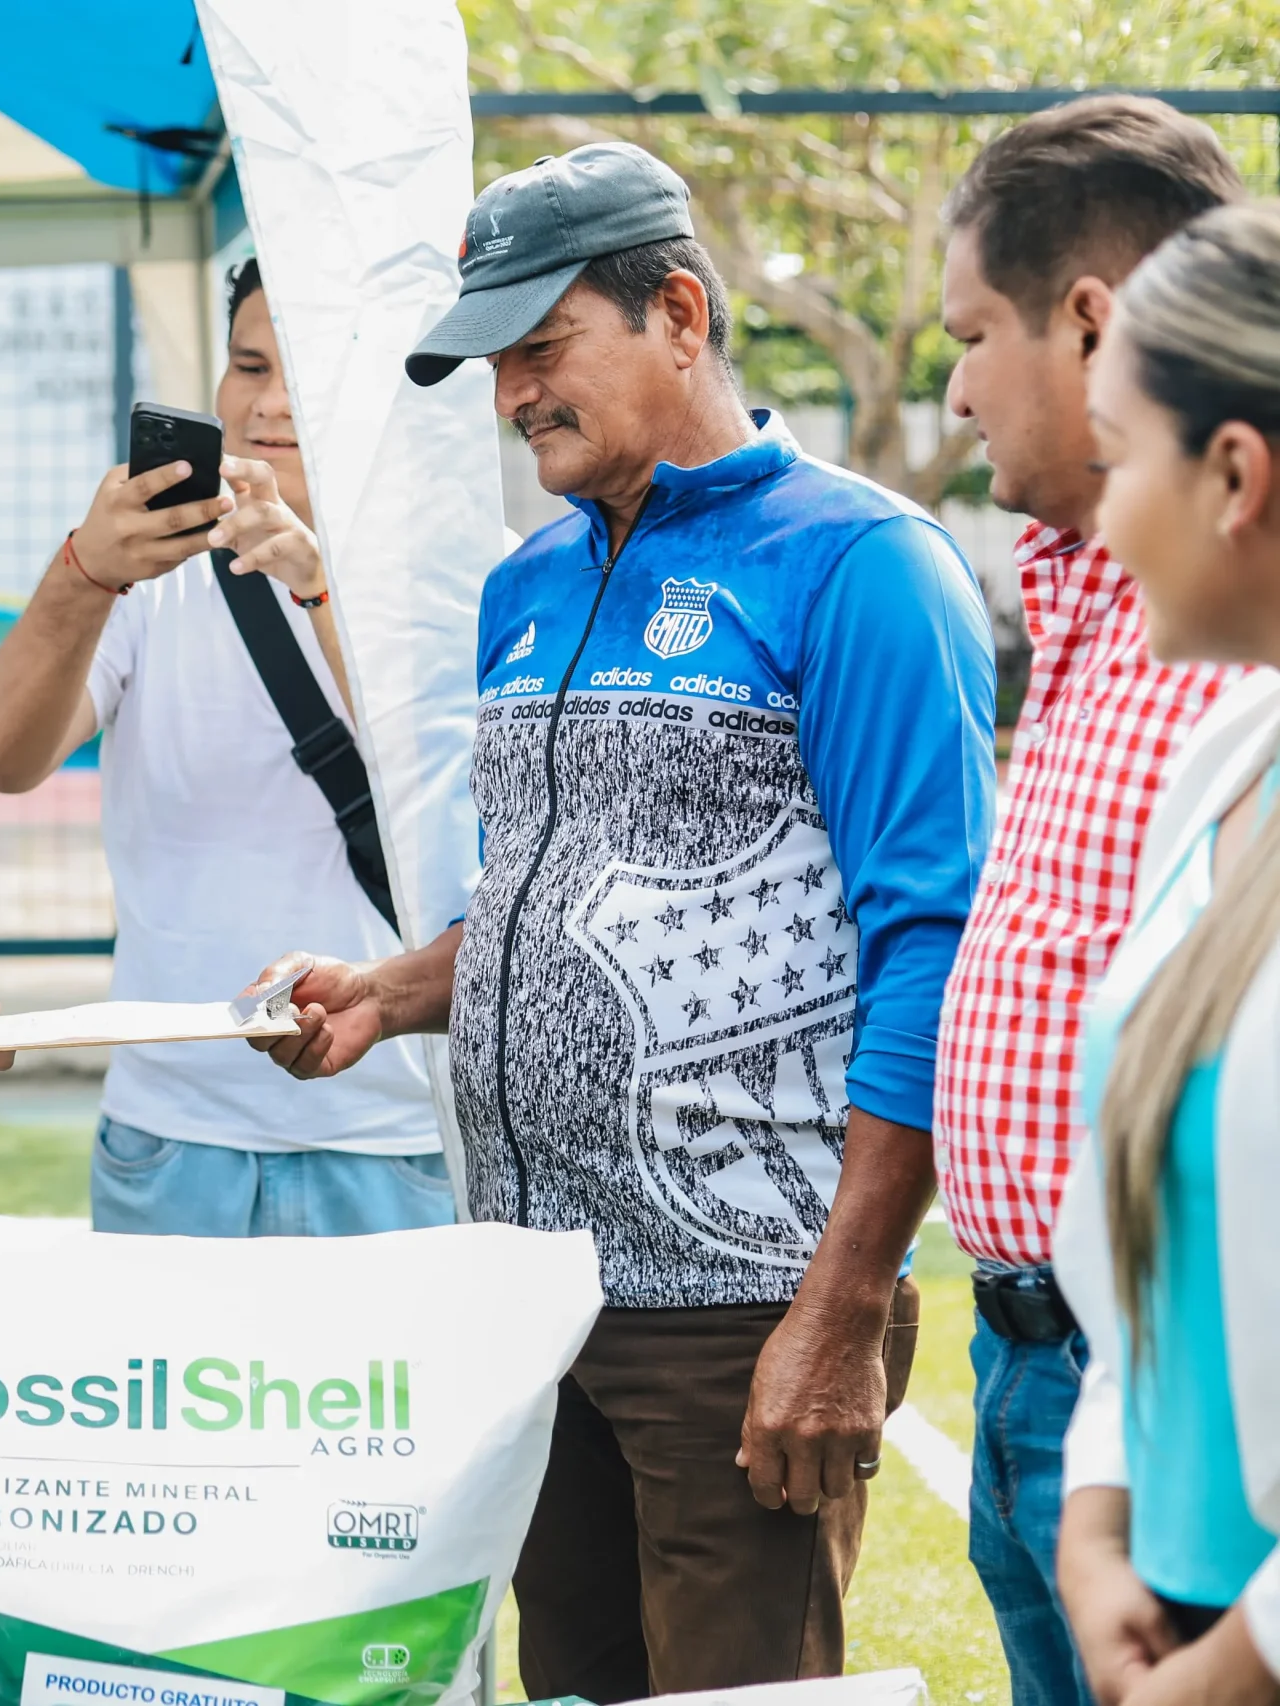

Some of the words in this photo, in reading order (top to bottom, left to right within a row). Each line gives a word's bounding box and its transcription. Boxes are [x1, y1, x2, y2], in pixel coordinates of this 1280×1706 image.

[647, 612, 709, 655] EMELEC
[505, 645, 535, 665] adidas
[500, 674, 545, 697] adidas
[590, 667, 653, 688] adidas
[670, 673, 751, 702] adidas
[511, 699, 556, 719] adida
[619, 696, 694, 723] adidas
[708, 708, 796, 736] adidas
[310, 1435, 416, 1457] AGRO
[125, 1481, 259, 1502] MINERAL
[333, 1510, 413, 1538] OMRI
[333, 1536, 413, 1550] LISTED
[45, 1673, 156, 1704] PRODUCTO
